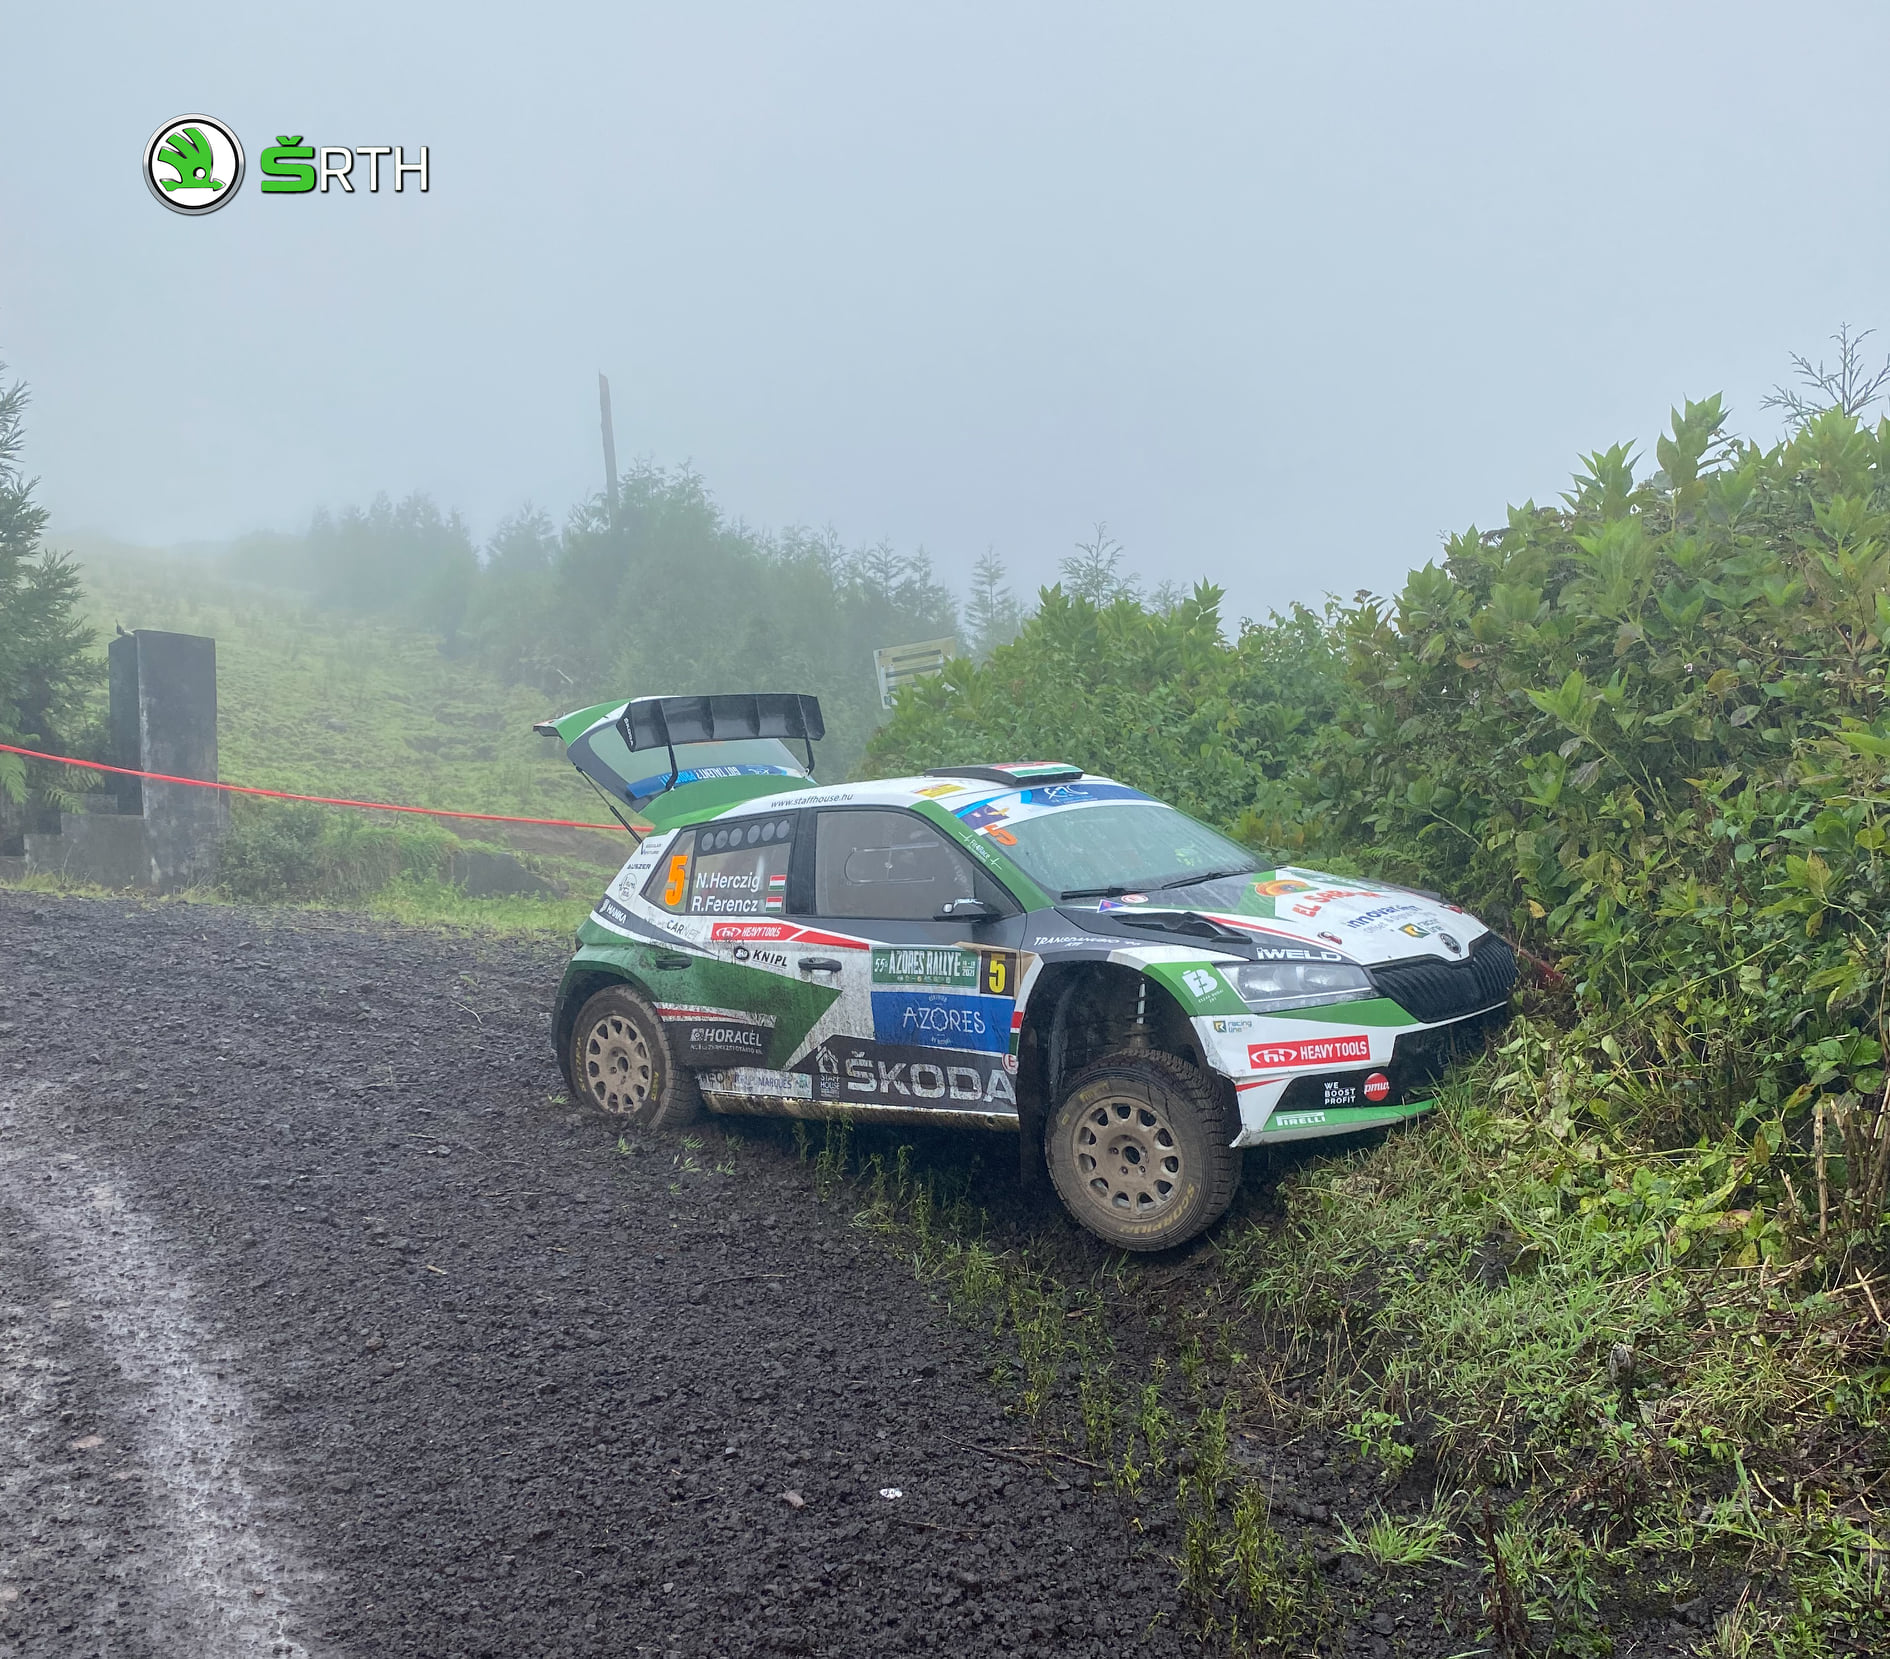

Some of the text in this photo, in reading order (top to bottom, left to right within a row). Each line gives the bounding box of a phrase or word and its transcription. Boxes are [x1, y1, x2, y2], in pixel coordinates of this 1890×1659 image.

[771, 794, 854, 808] www.staffhouse.hu
[984, 825, 1018, 846] 5
[664, 854, 689, 907] 5
[695, 872, 761, 903] N.Herczig
[691, 895, 759, 912] R.Ferencz
[741, 926, 782, 937] HEAVY TOOLS
[753, 949, 788, 967] KNIPL
[888, 950, 925, 975] AZORES
[926, 951, 962, 977] RALLYE
[962, 968, 976, 977] 2021
[989, 953, 1006, 993] 5
[902, 1006, 986, 1034] AZORES
[703, 1027, 762, 1046] HORACÉL
[1300, 1041, 1368, 1060] HEAVY TOOLS
[820, 1080, 840, 1089] HOUSE
[846, 1051, 1018, 1104] ŠKODA
[1324, 1081, 1339, 1090] WE
[1324, 1087, 1356, 1098] BOOST
[1324, 1095, 1356, 1105] PROFIT
[1276, 1112, 1326, 1127] PIRELLI
